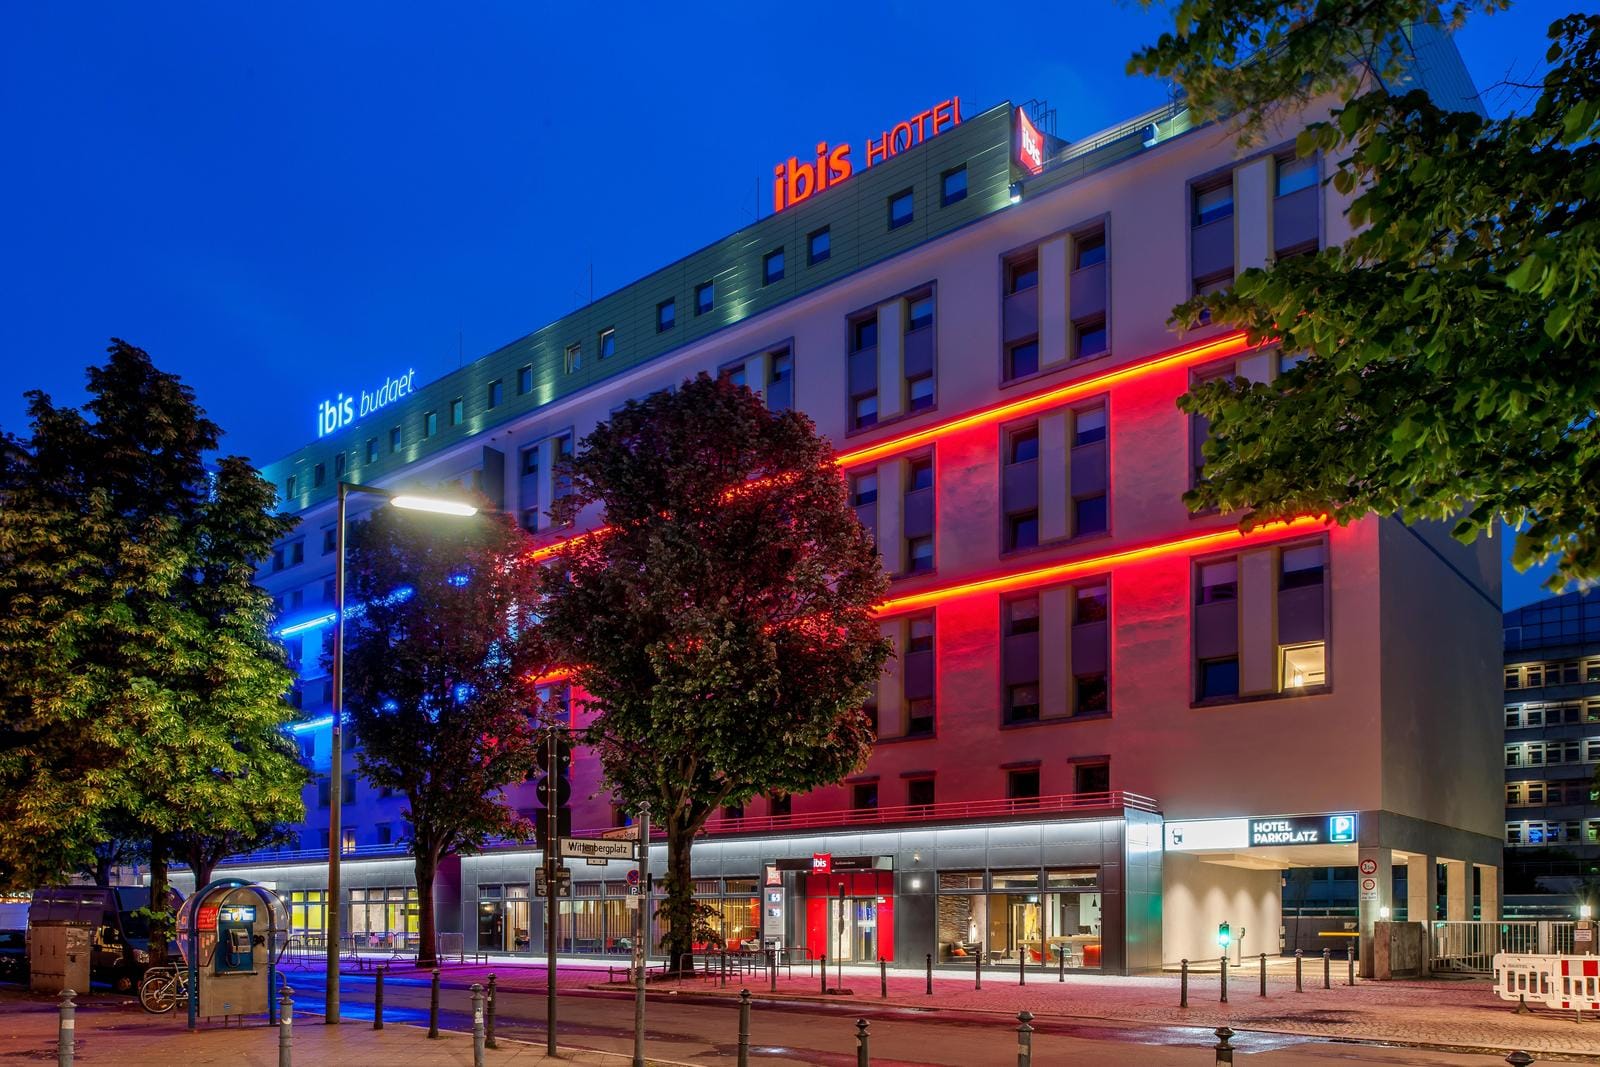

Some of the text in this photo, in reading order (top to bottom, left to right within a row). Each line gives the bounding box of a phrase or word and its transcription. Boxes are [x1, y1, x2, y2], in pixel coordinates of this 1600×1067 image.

[774, 96, 962, 212] ibis HOTEL
[1022, 128, 1041, 166] ibis
[318, 367, 415, 438] ibis budget
[1254, 821, 1292, 832] HOTEL
[1336, 818, 1349, 834] P
[1254, 832, 1318, 844] PARKPLATZ
[568, 841, 627, 855] Wittenbergplatz
[813, 858, 827, 868] ibis
